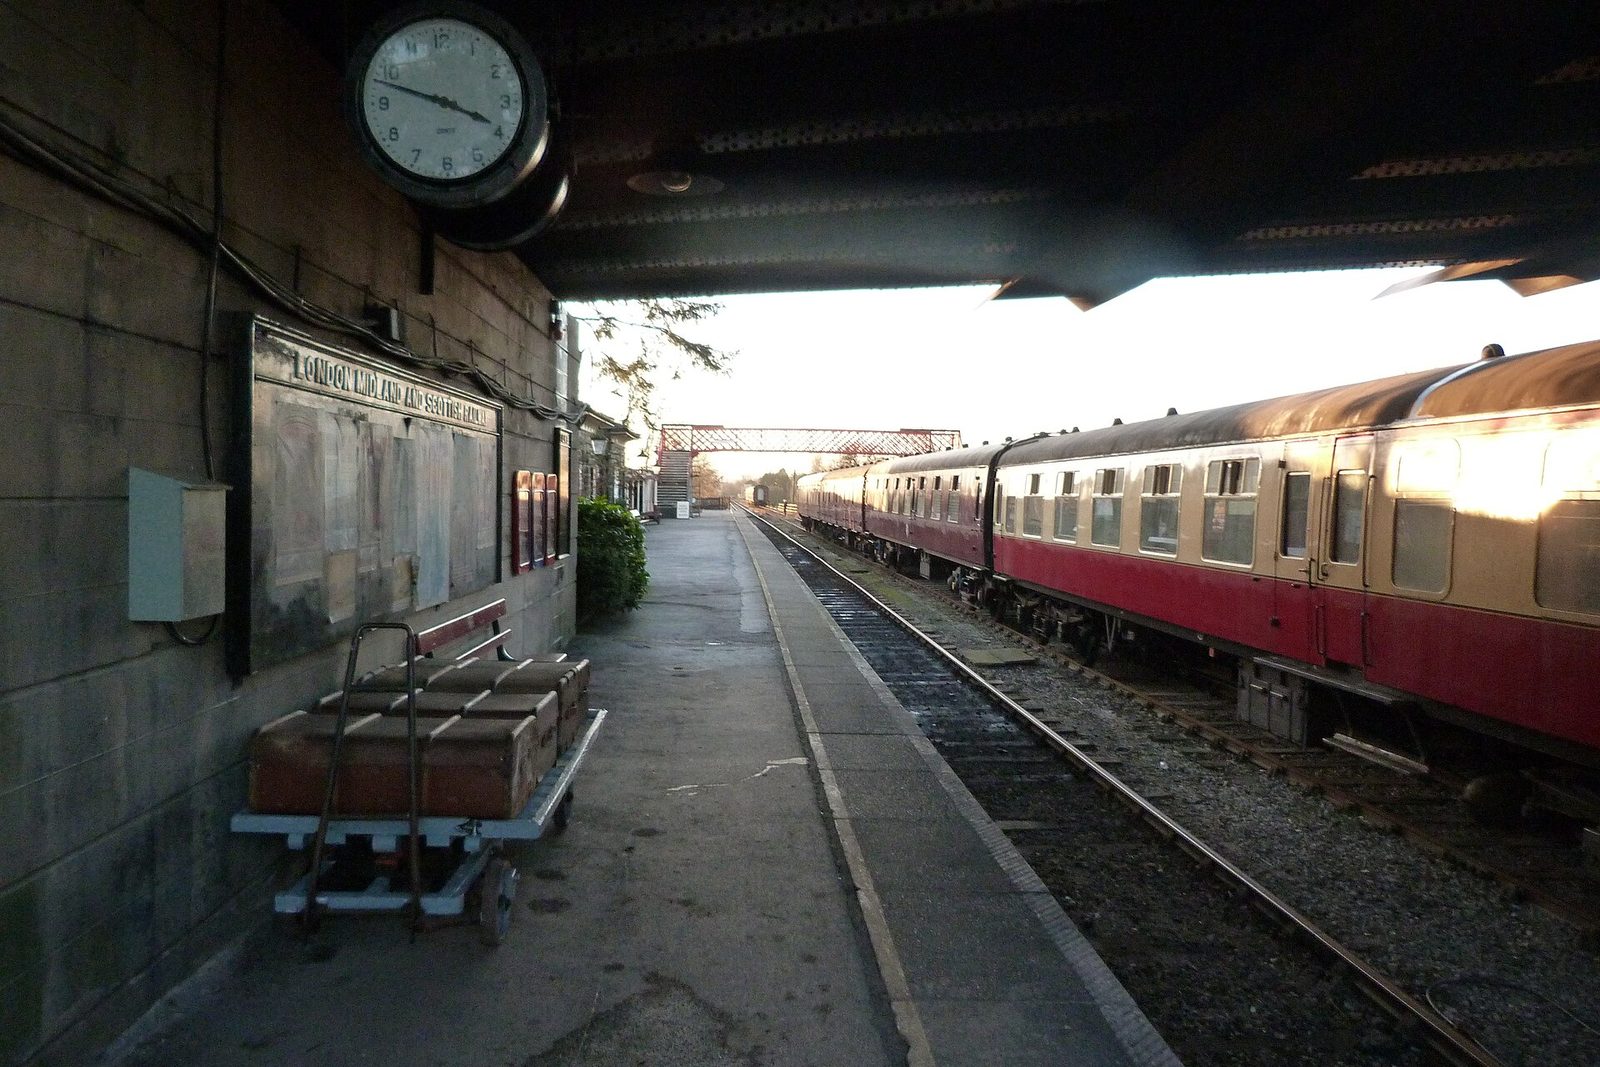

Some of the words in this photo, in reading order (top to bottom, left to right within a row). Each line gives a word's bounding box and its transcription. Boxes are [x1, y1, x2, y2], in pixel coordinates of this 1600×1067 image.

[405, 39, 418, 55] 11
[434, 34, 449, 49] 12
[383, 65, 400, 80] 10
[491, 65, 501, 79] 2
[379, 96, 389, 111] 9
[500, 94, 511, 109] 3
[388, 127, 399, 141] 8
[493, 125, 503, 139] 4
[411, 149, 422, 163] 7
[472, 148, 483, 162] 5
[442, 157, 453, 171] 6
[292, 350, 351, 392] LONDON
[353, 368, 402, 405] MIDLAND
[404, 386, 424, 410] AND
[425, 392, 462, 420] SCOTTISH
